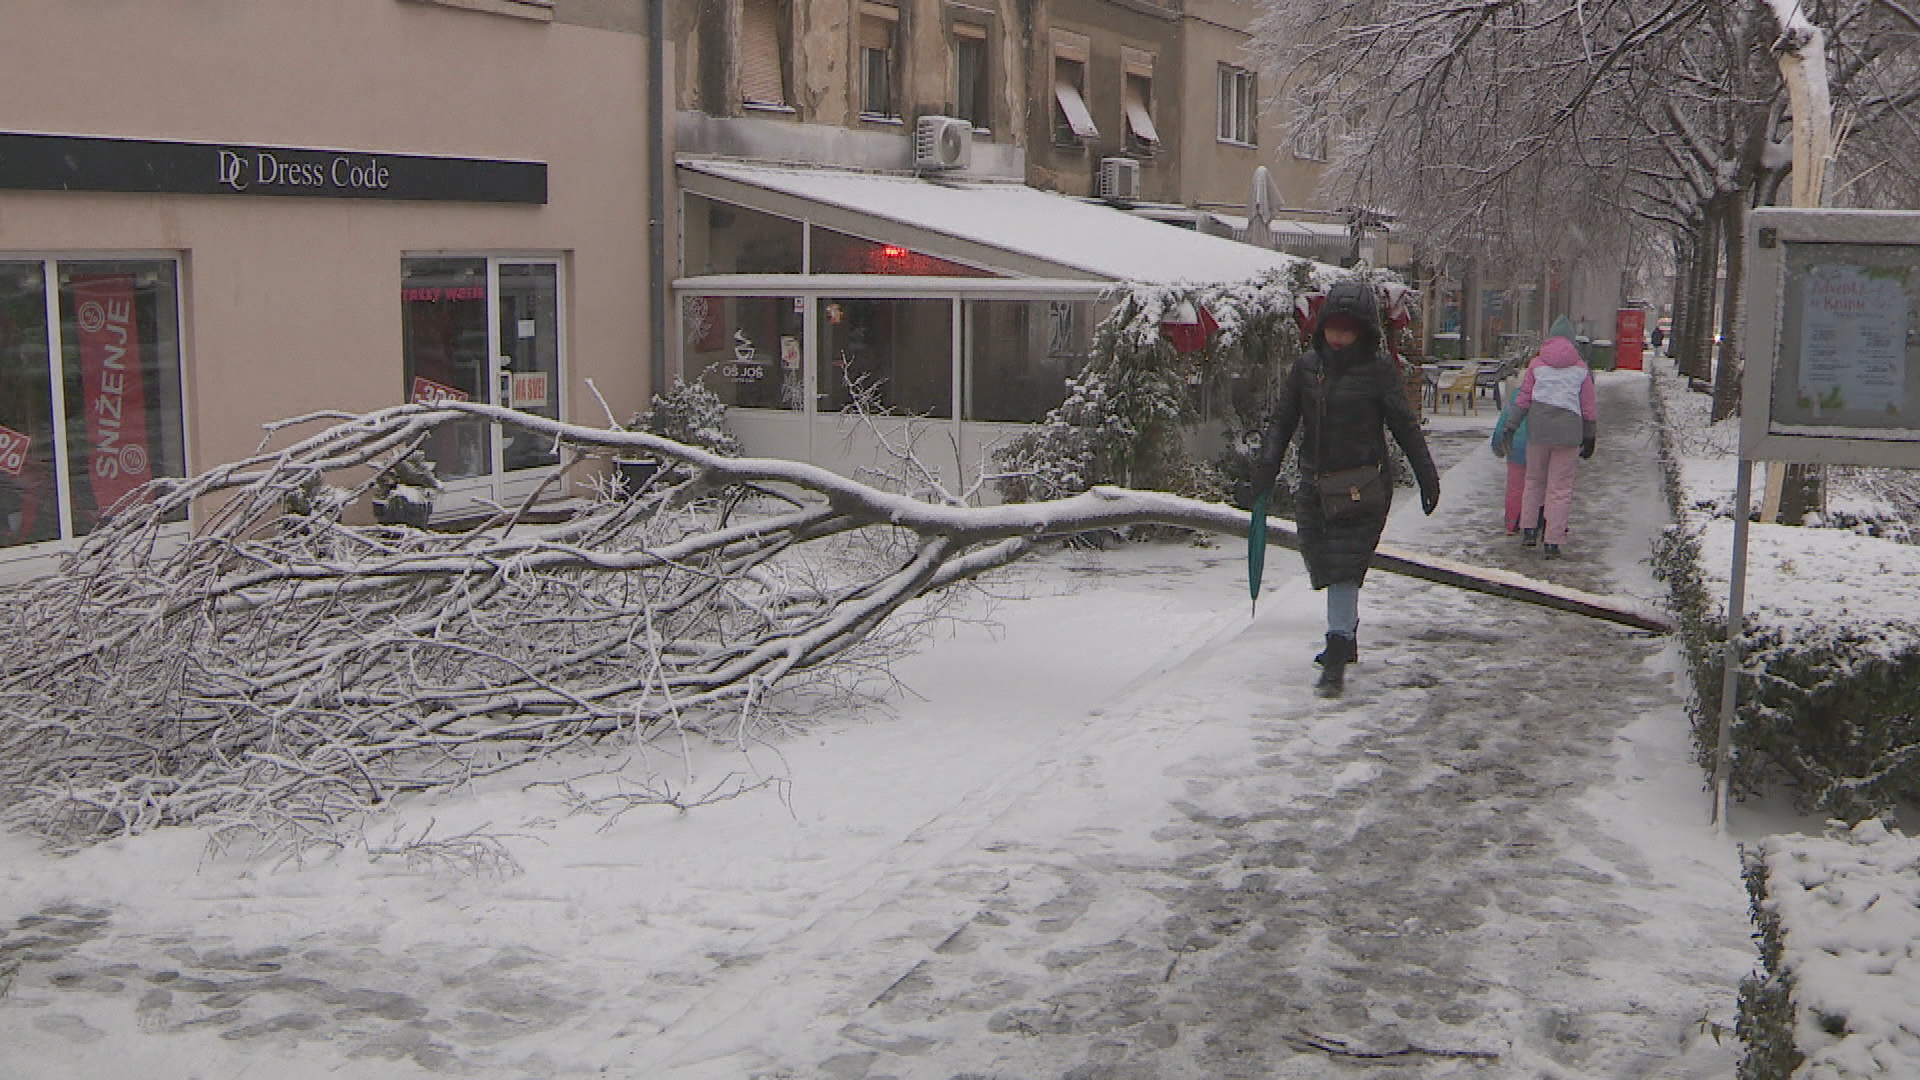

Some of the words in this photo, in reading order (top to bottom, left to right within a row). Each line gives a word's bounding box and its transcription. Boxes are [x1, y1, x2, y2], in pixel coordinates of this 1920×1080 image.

[256, 153, 324, 186] Dress
[331, 157, 390, 189] Code
[95, 299, 131, 479] SNIŽENJE
